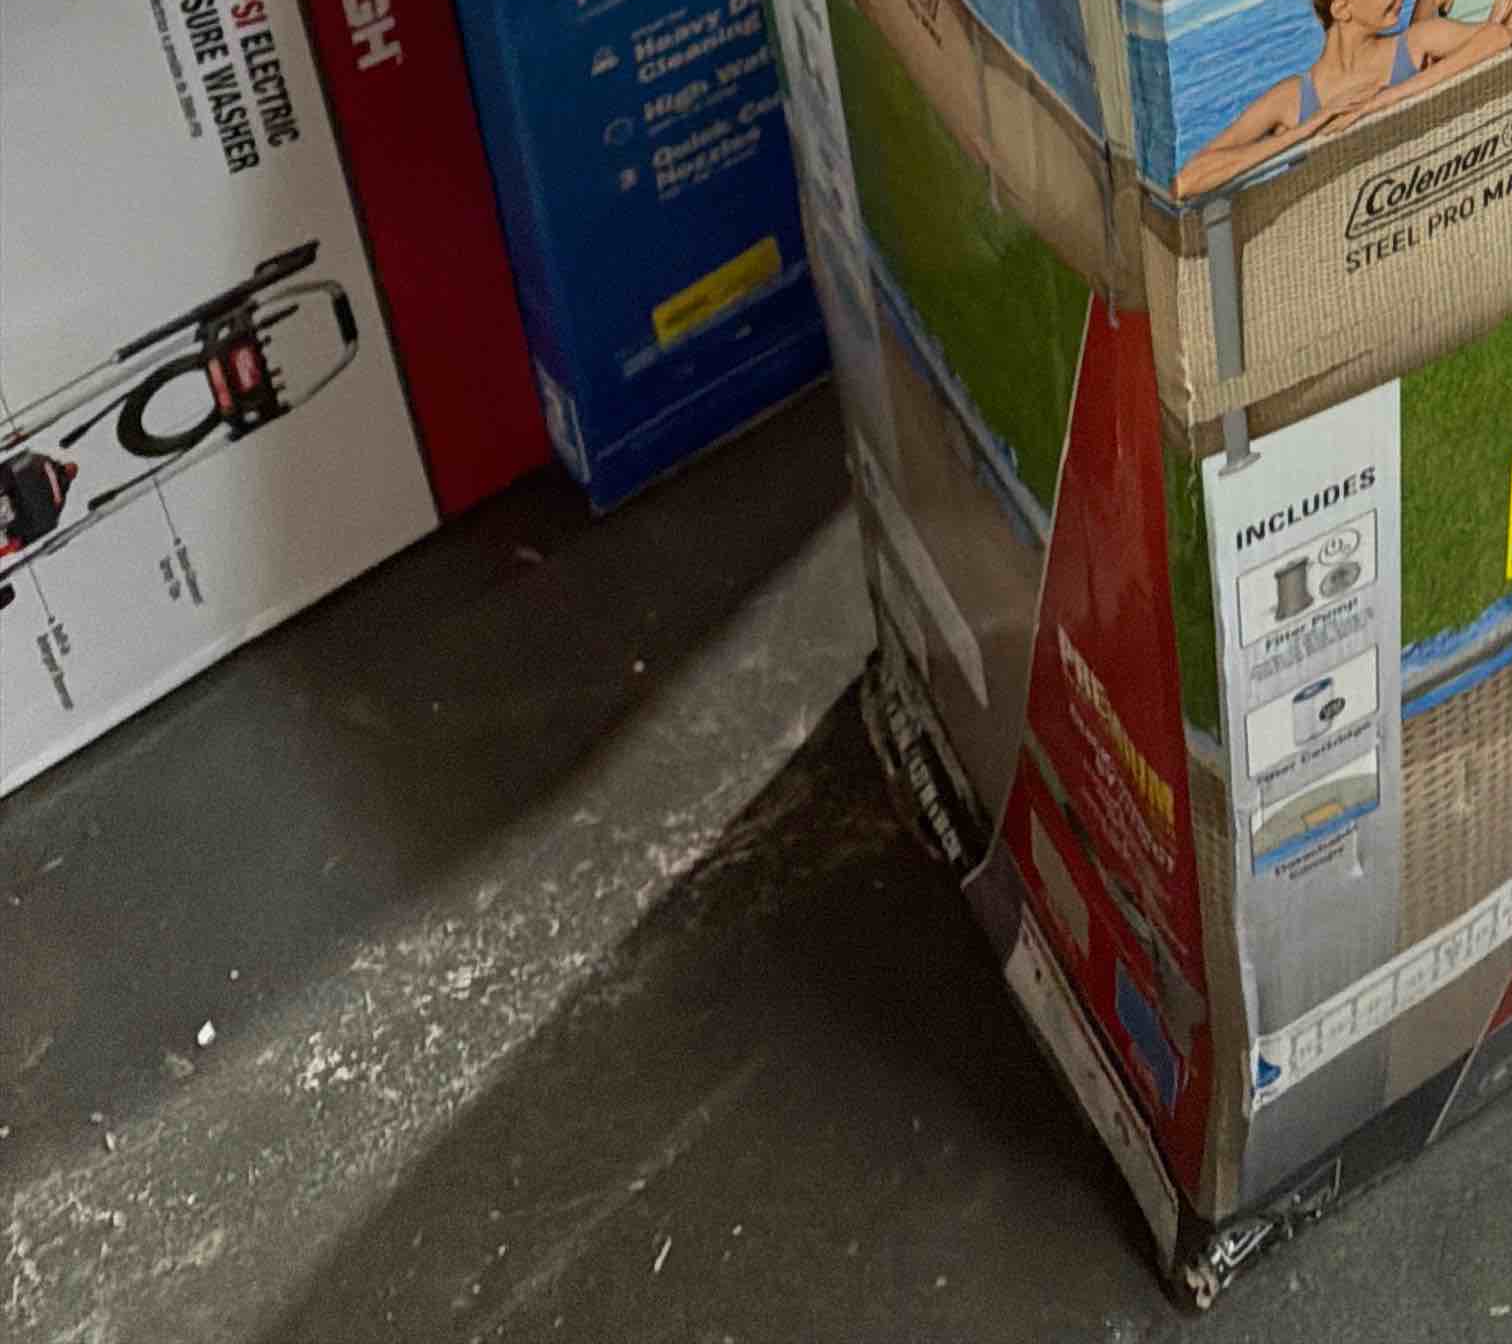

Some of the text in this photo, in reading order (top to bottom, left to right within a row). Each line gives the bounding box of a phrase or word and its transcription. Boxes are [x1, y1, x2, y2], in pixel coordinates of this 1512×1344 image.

[201, 61, 261, 176] WASHER
[240, 25, 302, 149] ELECTRIC
[1366, 132, 1500, 216] Coleman
[1345, 227, 1420, 274] STEEL
[1427, 194, 1475, 238] PRO
[1235, 466, 1376, 551] INCLUDES
[1265, 596, 1359, 652] Filter Pump
